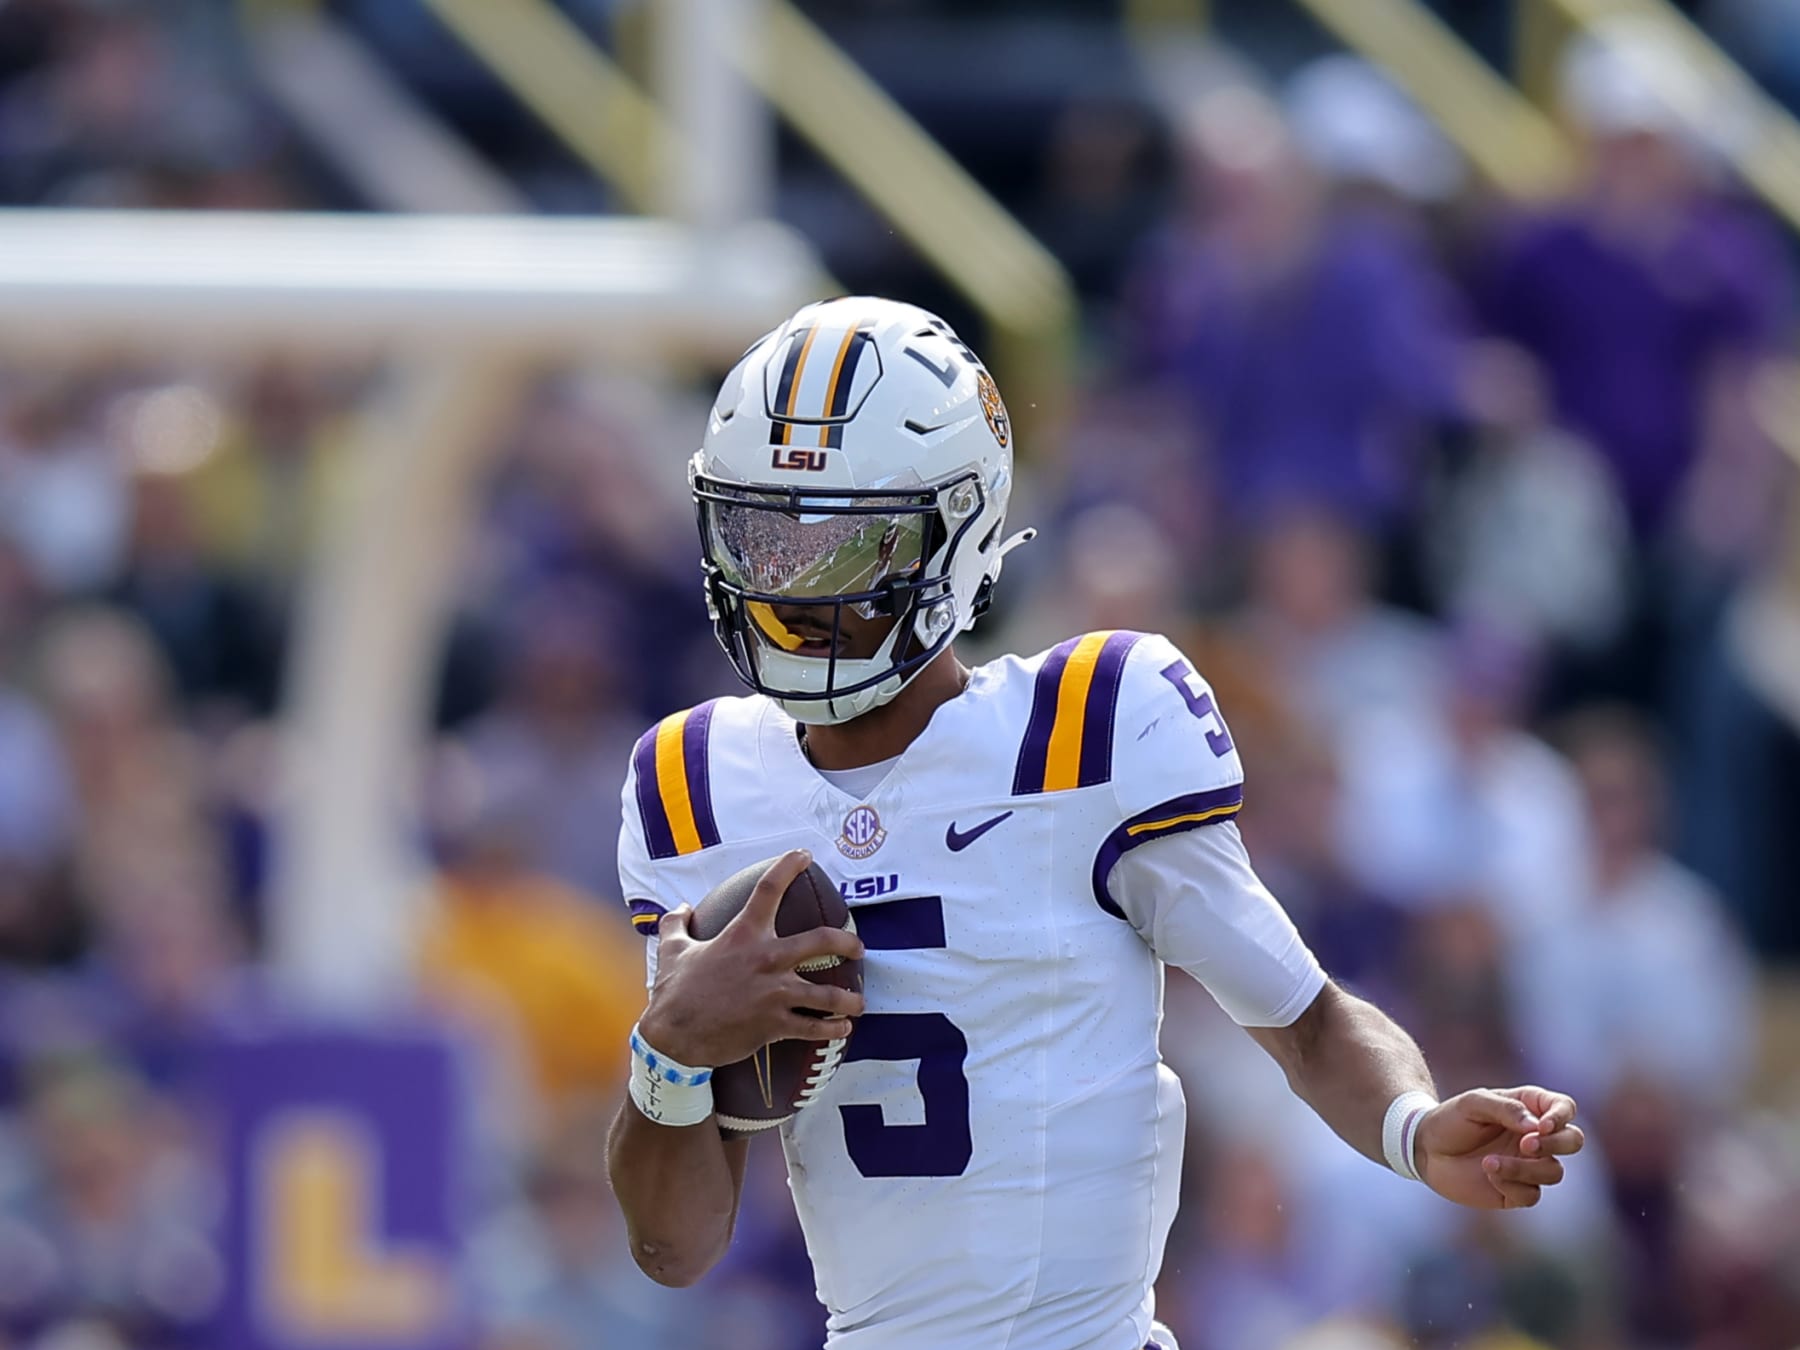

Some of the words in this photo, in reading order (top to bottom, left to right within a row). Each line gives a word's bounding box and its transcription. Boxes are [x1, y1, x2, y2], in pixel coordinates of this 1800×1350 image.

[771, 449, 827, 472] LSU
[1159, 658, 1233, 758] 5
[845, 808, 876, 845] SEC
[840, 874, 899, 900] LSU
[838, 895, 973, 1178] 5
